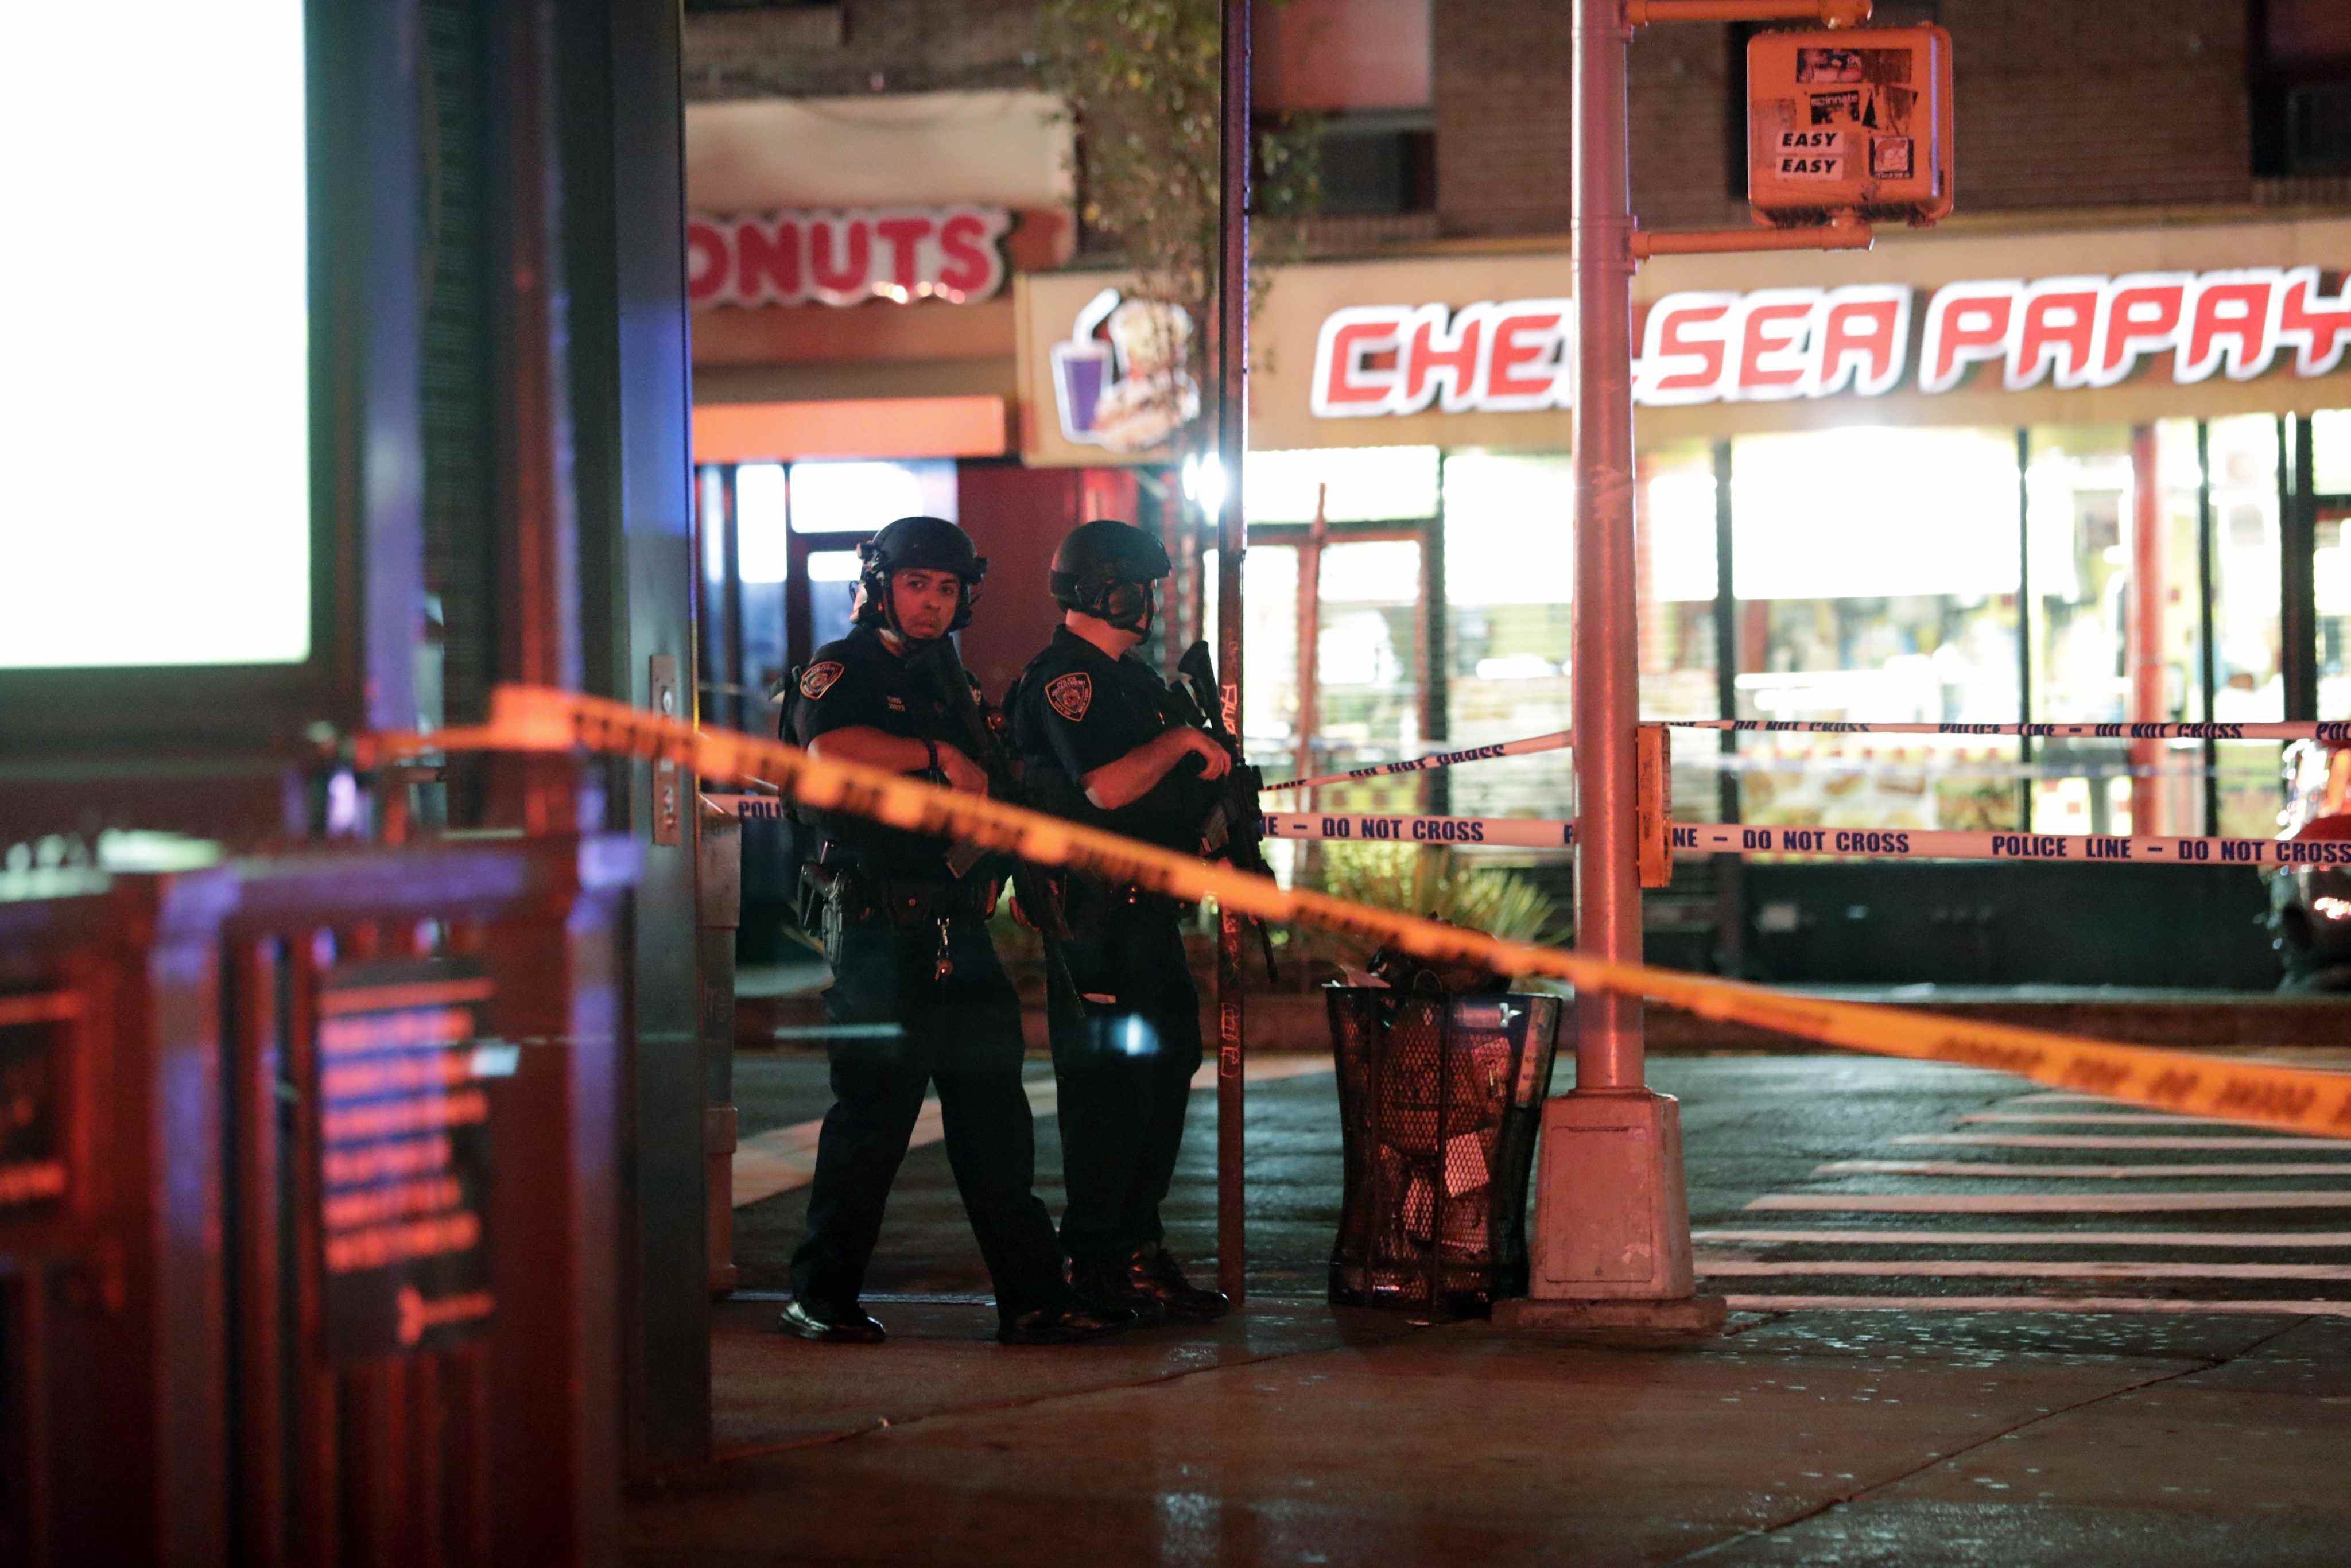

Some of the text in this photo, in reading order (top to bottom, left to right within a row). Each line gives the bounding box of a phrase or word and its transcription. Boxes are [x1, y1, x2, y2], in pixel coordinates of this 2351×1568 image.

[1782, 133, 1837, 147] EASY
[1782, 158, 1837, 173] EASY
[1311, 282, 1912, 418] CHESEA
[1322, 818, 1350, 837] DO
[1361, 819, 1402, 839] NOT
[1412, 820, 1484, 841] CROSS
[1743, 830, 1771, 849] DO
[1783, 831, 1825, 851] NOT
[1836, 832, 1909, 853] CROSS
[1992, 836, 2067, 857] POLICE
[2086, 837, 2131, 859] LINE
[2179, 840, 2209, 861] DO
[2221, 841, 2264, 861] NOT
[2276, 841, 2351, 863] CROSS
